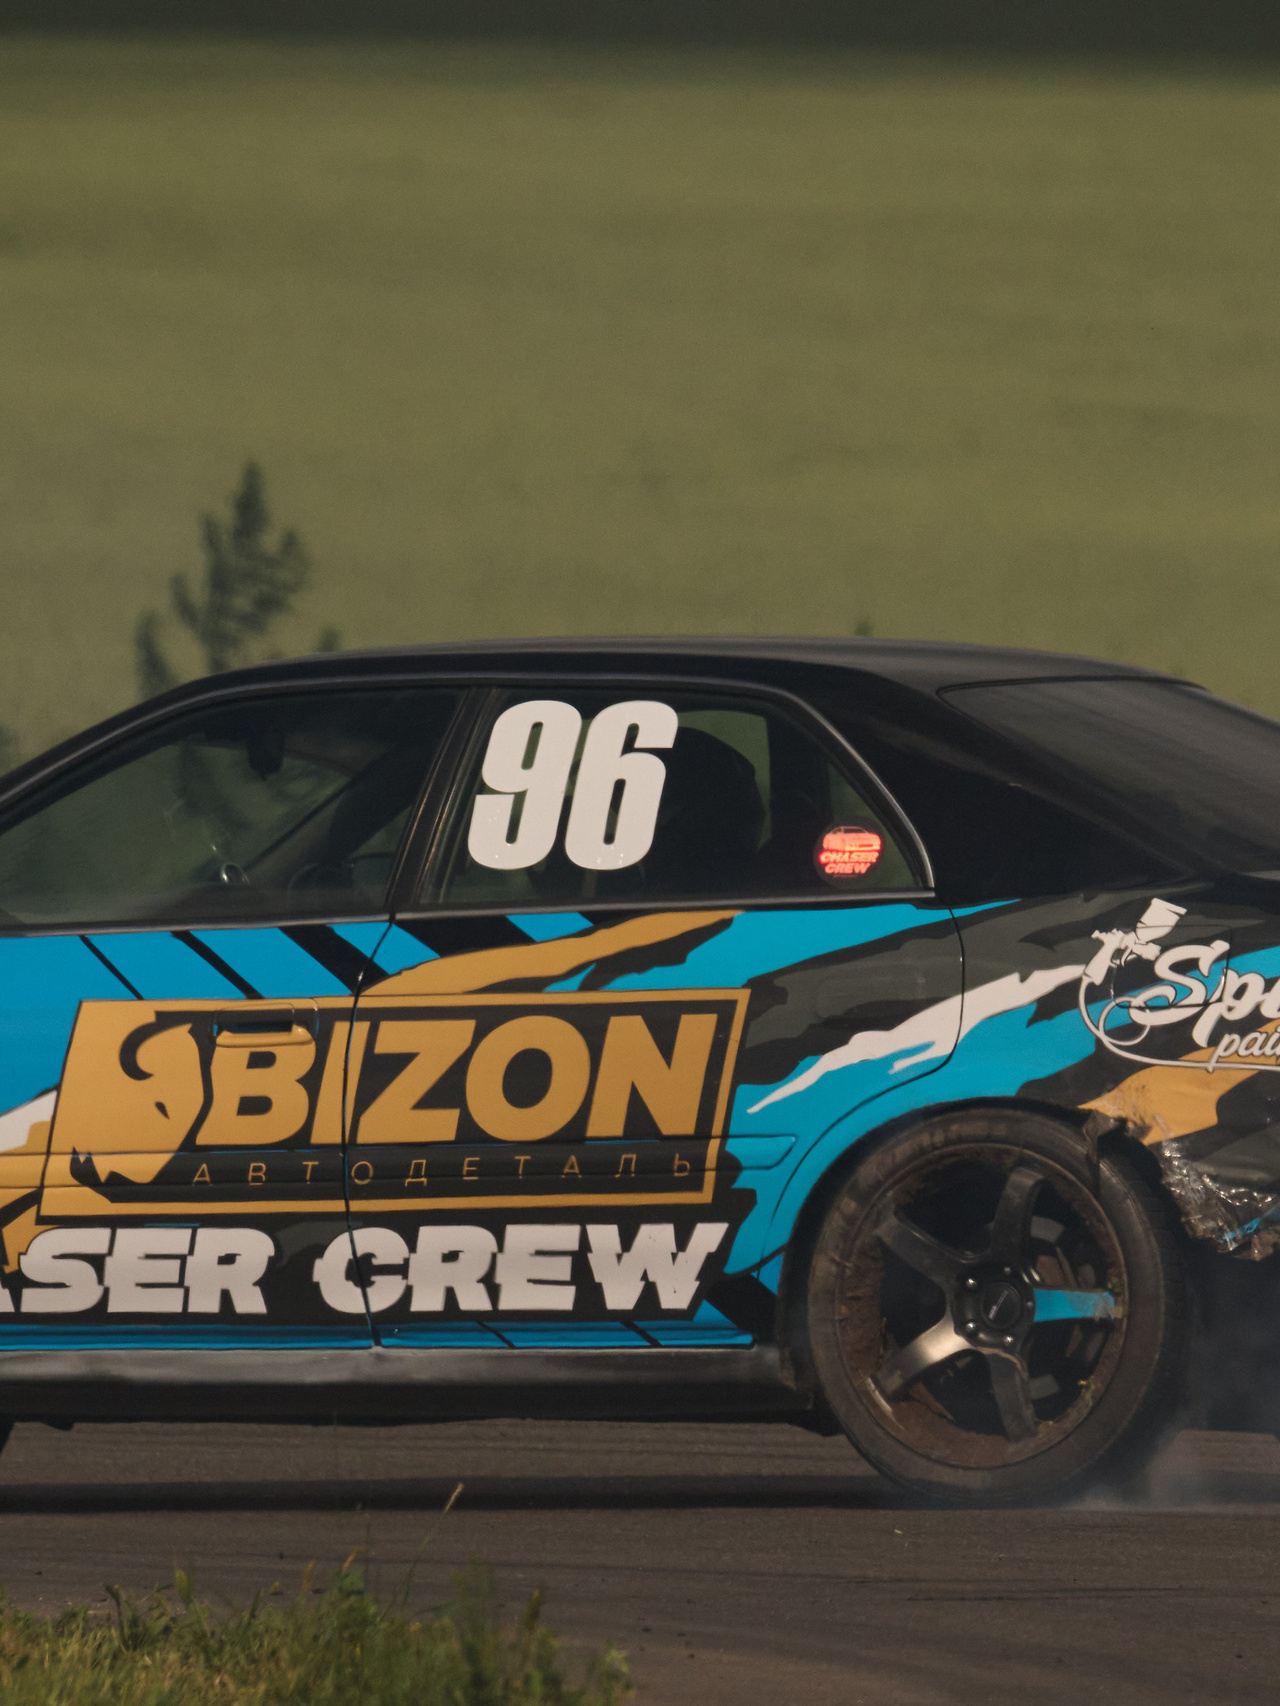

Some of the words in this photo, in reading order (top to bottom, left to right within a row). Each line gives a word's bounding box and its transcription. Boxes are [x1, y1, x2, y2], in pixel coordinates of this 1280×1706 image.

[467, 700, 679, 871] 96
[820, 851, 879, 863] CHASER
[825, 863, 871, 874] CREW
[196, 1013, 718, 1146] BIZON
[191, 1153, 692, 1188] АВТОДЕТАЛЬ
[0, 1226, 275, 1314] SER
[313, 1222, 730, 1314] CREW
